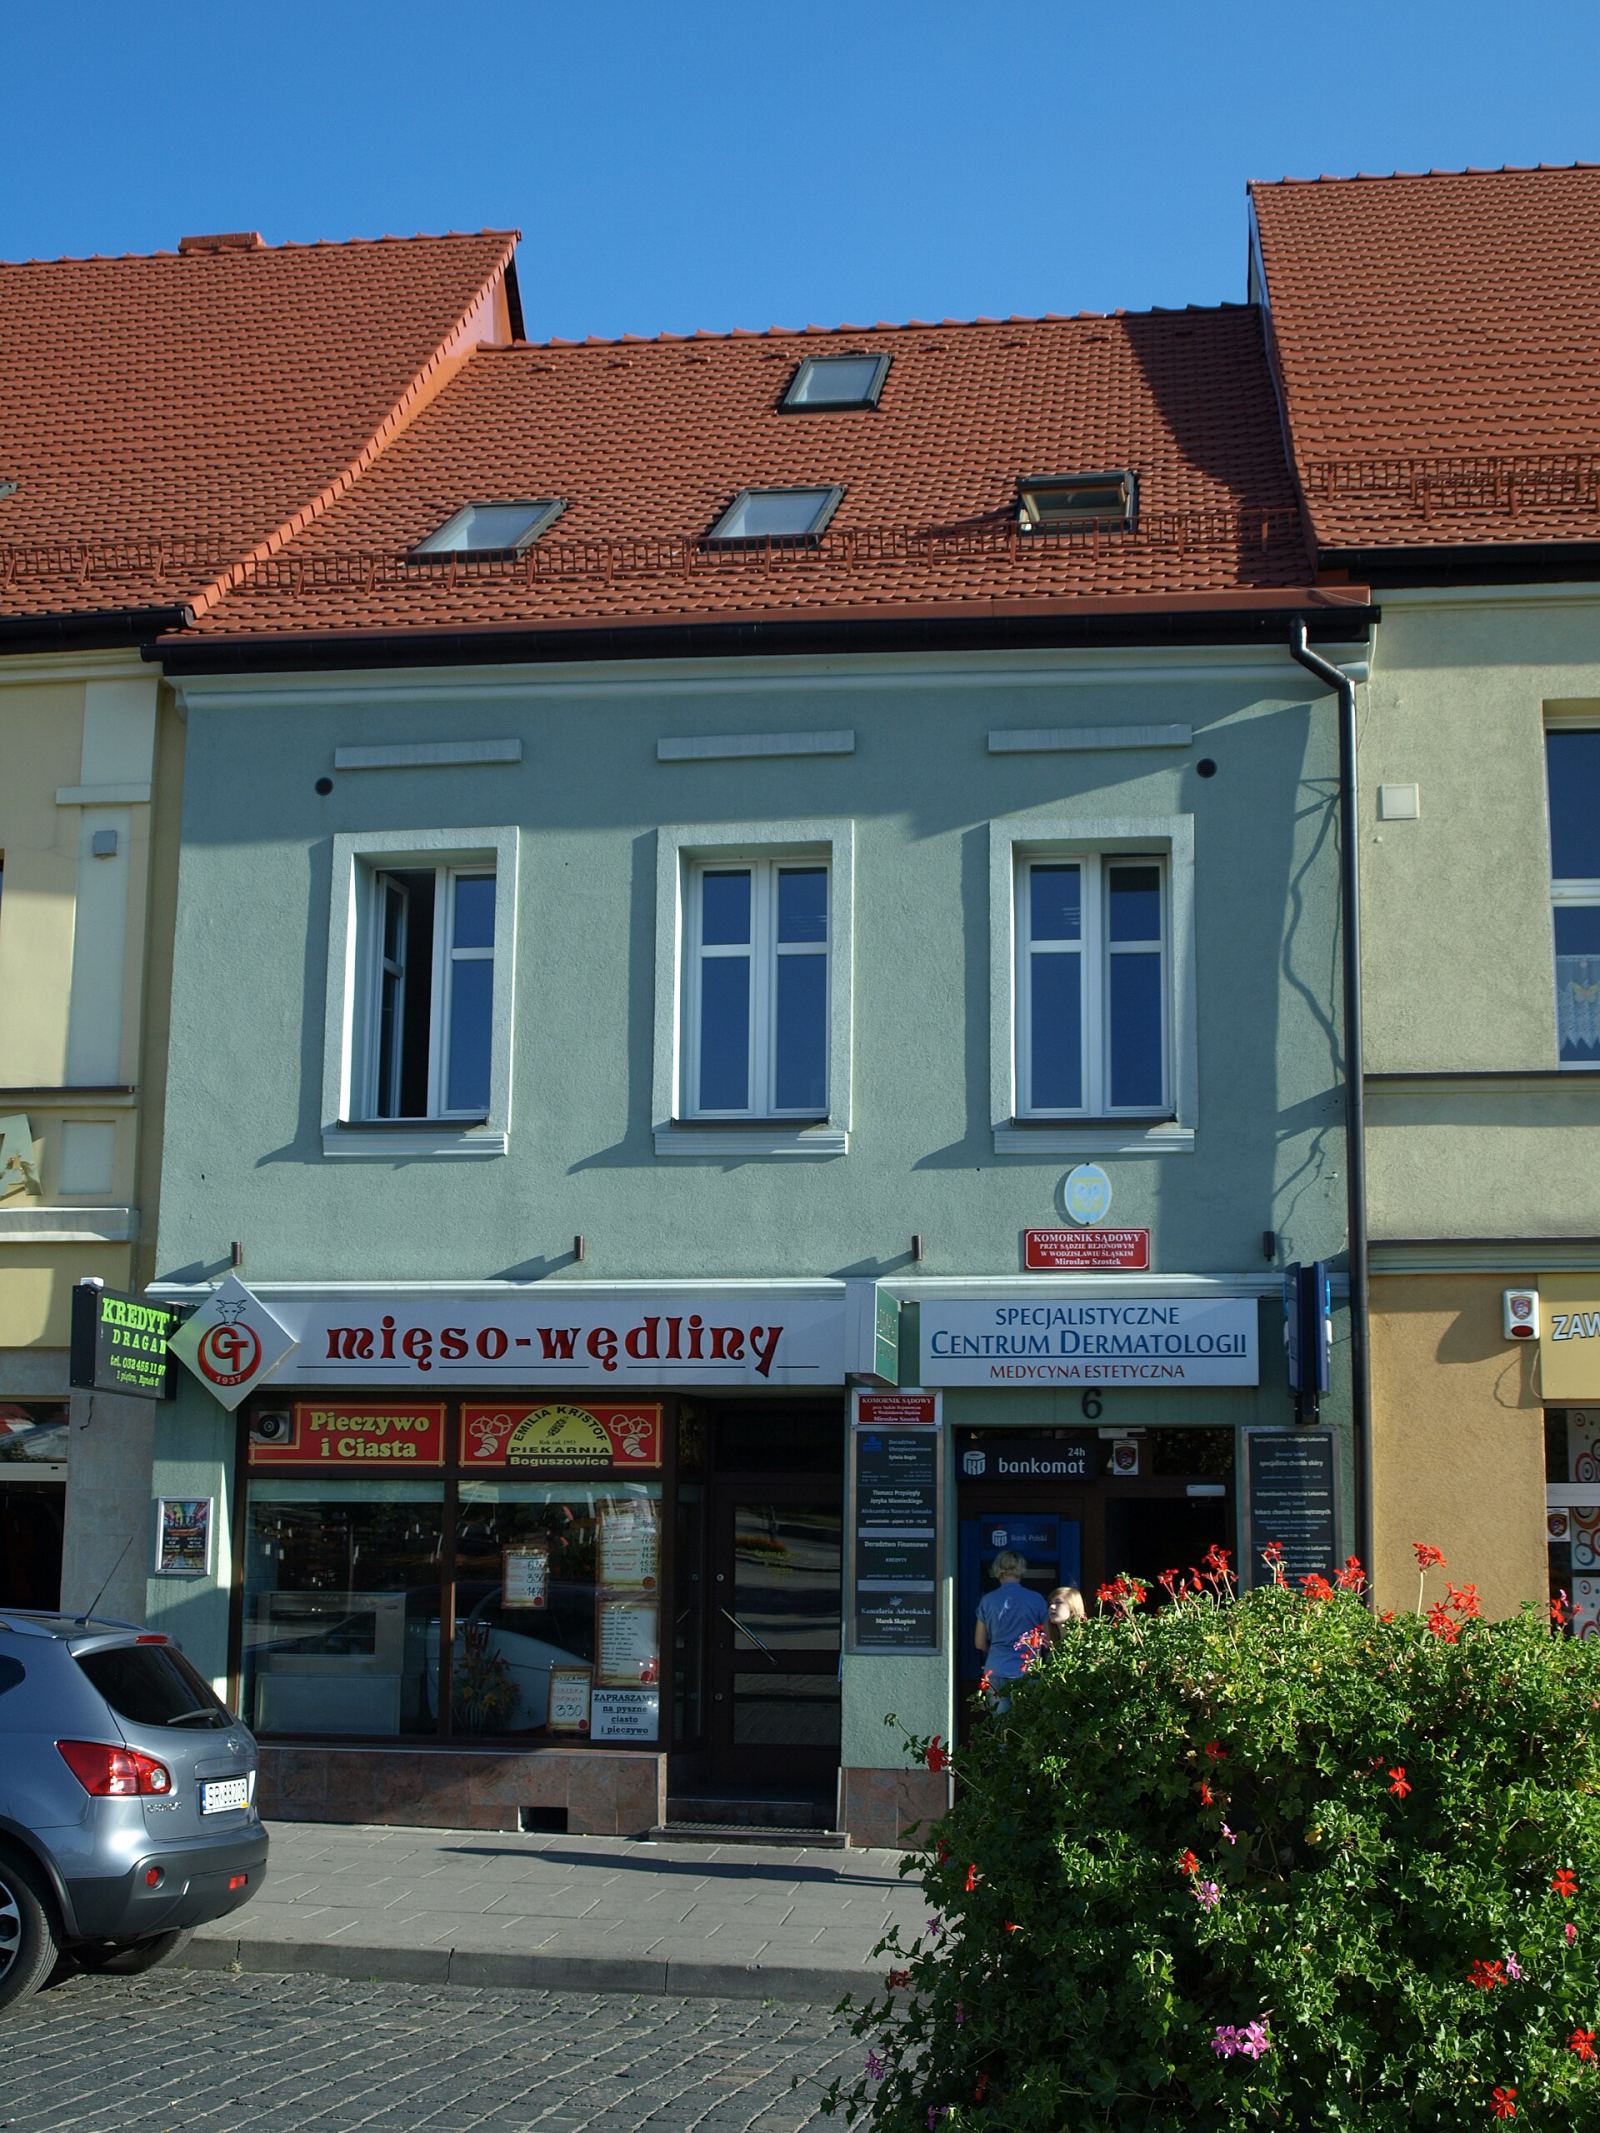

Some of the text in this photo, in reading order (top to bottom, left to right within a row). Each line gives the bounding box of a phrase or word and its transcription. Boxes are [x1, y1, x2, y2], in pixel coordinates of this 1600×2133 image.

[1033, 1234, 1140, 1243] KOMORNIK SĄDOWY
[101, 1297, 178, 1336] KREDYT
[995, 1307, 1180, 1329] SPECJALISTYCZNE
[211, 1327, 249, 1372] GT
[325, 1315, 784, 1378] mięso-wędliny
[150, 1362, 158, 1374] 11
[989, 1364, 1185, 1379] MEDYCYNA ESTETYCZNA
[215, 1375, 242, 1385] 1937
[1081, 1388, 1103, 1420] 6
[309, 1411, 431, 1436] Pieczywo
[513, 1406, 608, 1442] EMILIA KRISTOF
[321, 1437, 418, 1458] i Ciasta
[510, 1446, 610, 1454] PIEKARNIA
[1067, 1448, 1086, 1457] 24h
[510, 1456, 609, 1468] Boguszowice
[999, 1458, 1086, 1474] bankomat
[593, 1693, 657, 1702] ZAPRASZAMY
[611, 1715, 639, 1723] ciasto
